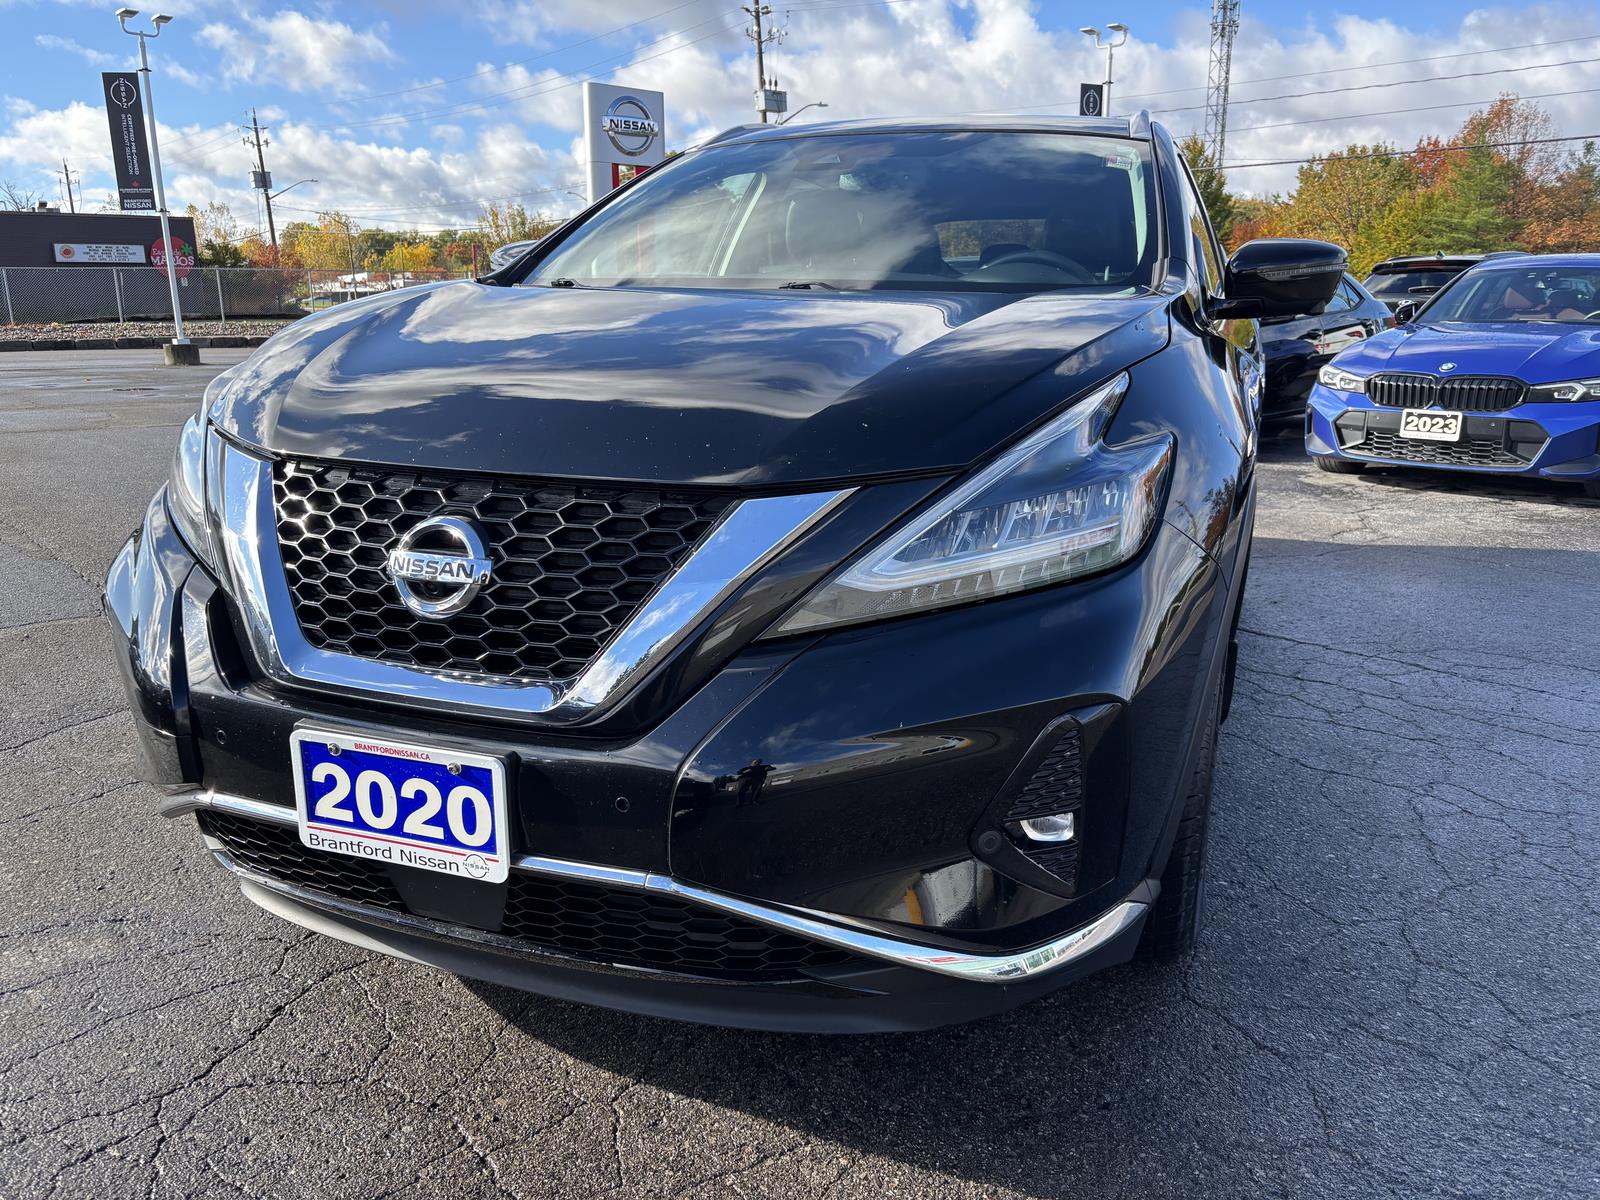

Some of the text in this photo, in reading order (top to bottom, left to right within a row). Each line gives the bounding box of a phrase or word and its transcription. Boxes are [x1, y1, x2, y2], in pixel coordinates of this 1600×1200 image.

[119, 77, 127, 108] NISSAN
[610, 118, 654, 132] NISSAN
[120, 114, 134, 175] INTELLIGENT SELECTION
[132, 142, 140, 176] PRE-OWNED
[1404, 416, 1457, 434] 2023
[392, 556, 474, 579] NISSAN
[354, 742, 430, 761] BRANTFORDNISSAN.CA
[312, 762, 492, 847] 2020
[309, 833, 459, 873] Brantford Nissan
[462, 862, 490, 872] NISSAN
